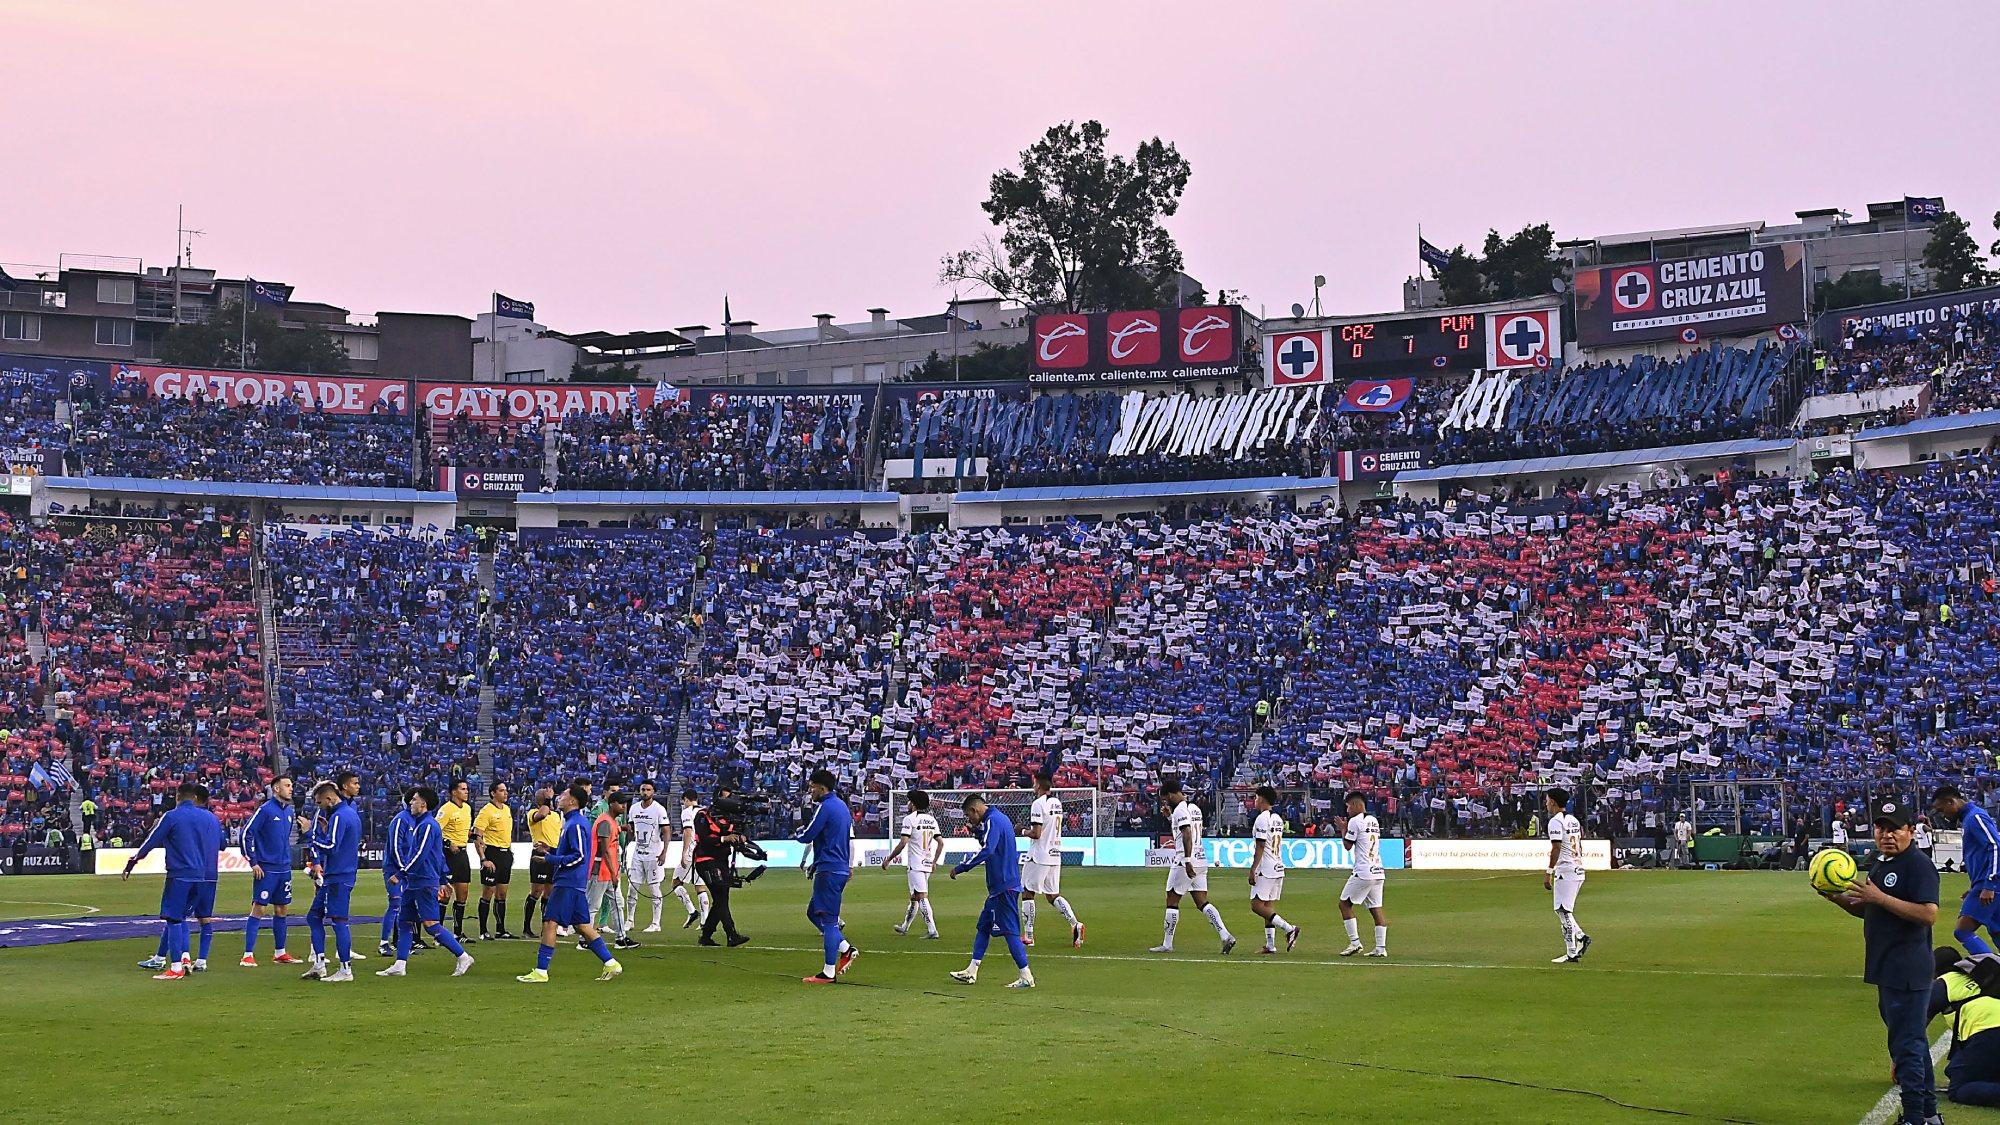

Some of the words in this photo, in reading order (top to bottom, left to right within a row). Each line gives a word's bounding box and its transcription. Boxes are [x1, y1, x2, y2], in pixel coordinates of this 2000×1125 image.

[1660, 251, 1765, 283] CEMENTO
[1661, 286, 1712, 309] CRUZ
[1715, 277, 1766, 302] AZUL
[1441, 315, 1474, 332] PUM
[1615, 319, 1663, 329] Empresa
[1671, 313, 1699, 324] 100%
[1707, 306, 1764, 319] Mexicana
[1342, 324, 1374, 341] CAZ
[1458, 335, 1468, 349] 0
[1353, 344, 1362, 358] 0
[1029, 371, 1095, 382] caliente.mx
[1100, 370, 1167, 381] caliente.mx
[1172, 365, 1239, 378] caliente.mx
[153, 371, 365, 410] GATORADE
[1815, 439, 1825, 450] 6
[1380, 450, 1420, 462] CEMENTO
[1380, 462, 1400, 472] CRUZ
[1400, 460, 1421, 470] AZUL
[483, 473, 525, 482] CEMENTO
[483, 483, 503, 491] CRUZ
[504, 483, 524, 491] AZUL
[1378, 480, 1387, 491] 7
[22, 856, 42, 866] RUZ
